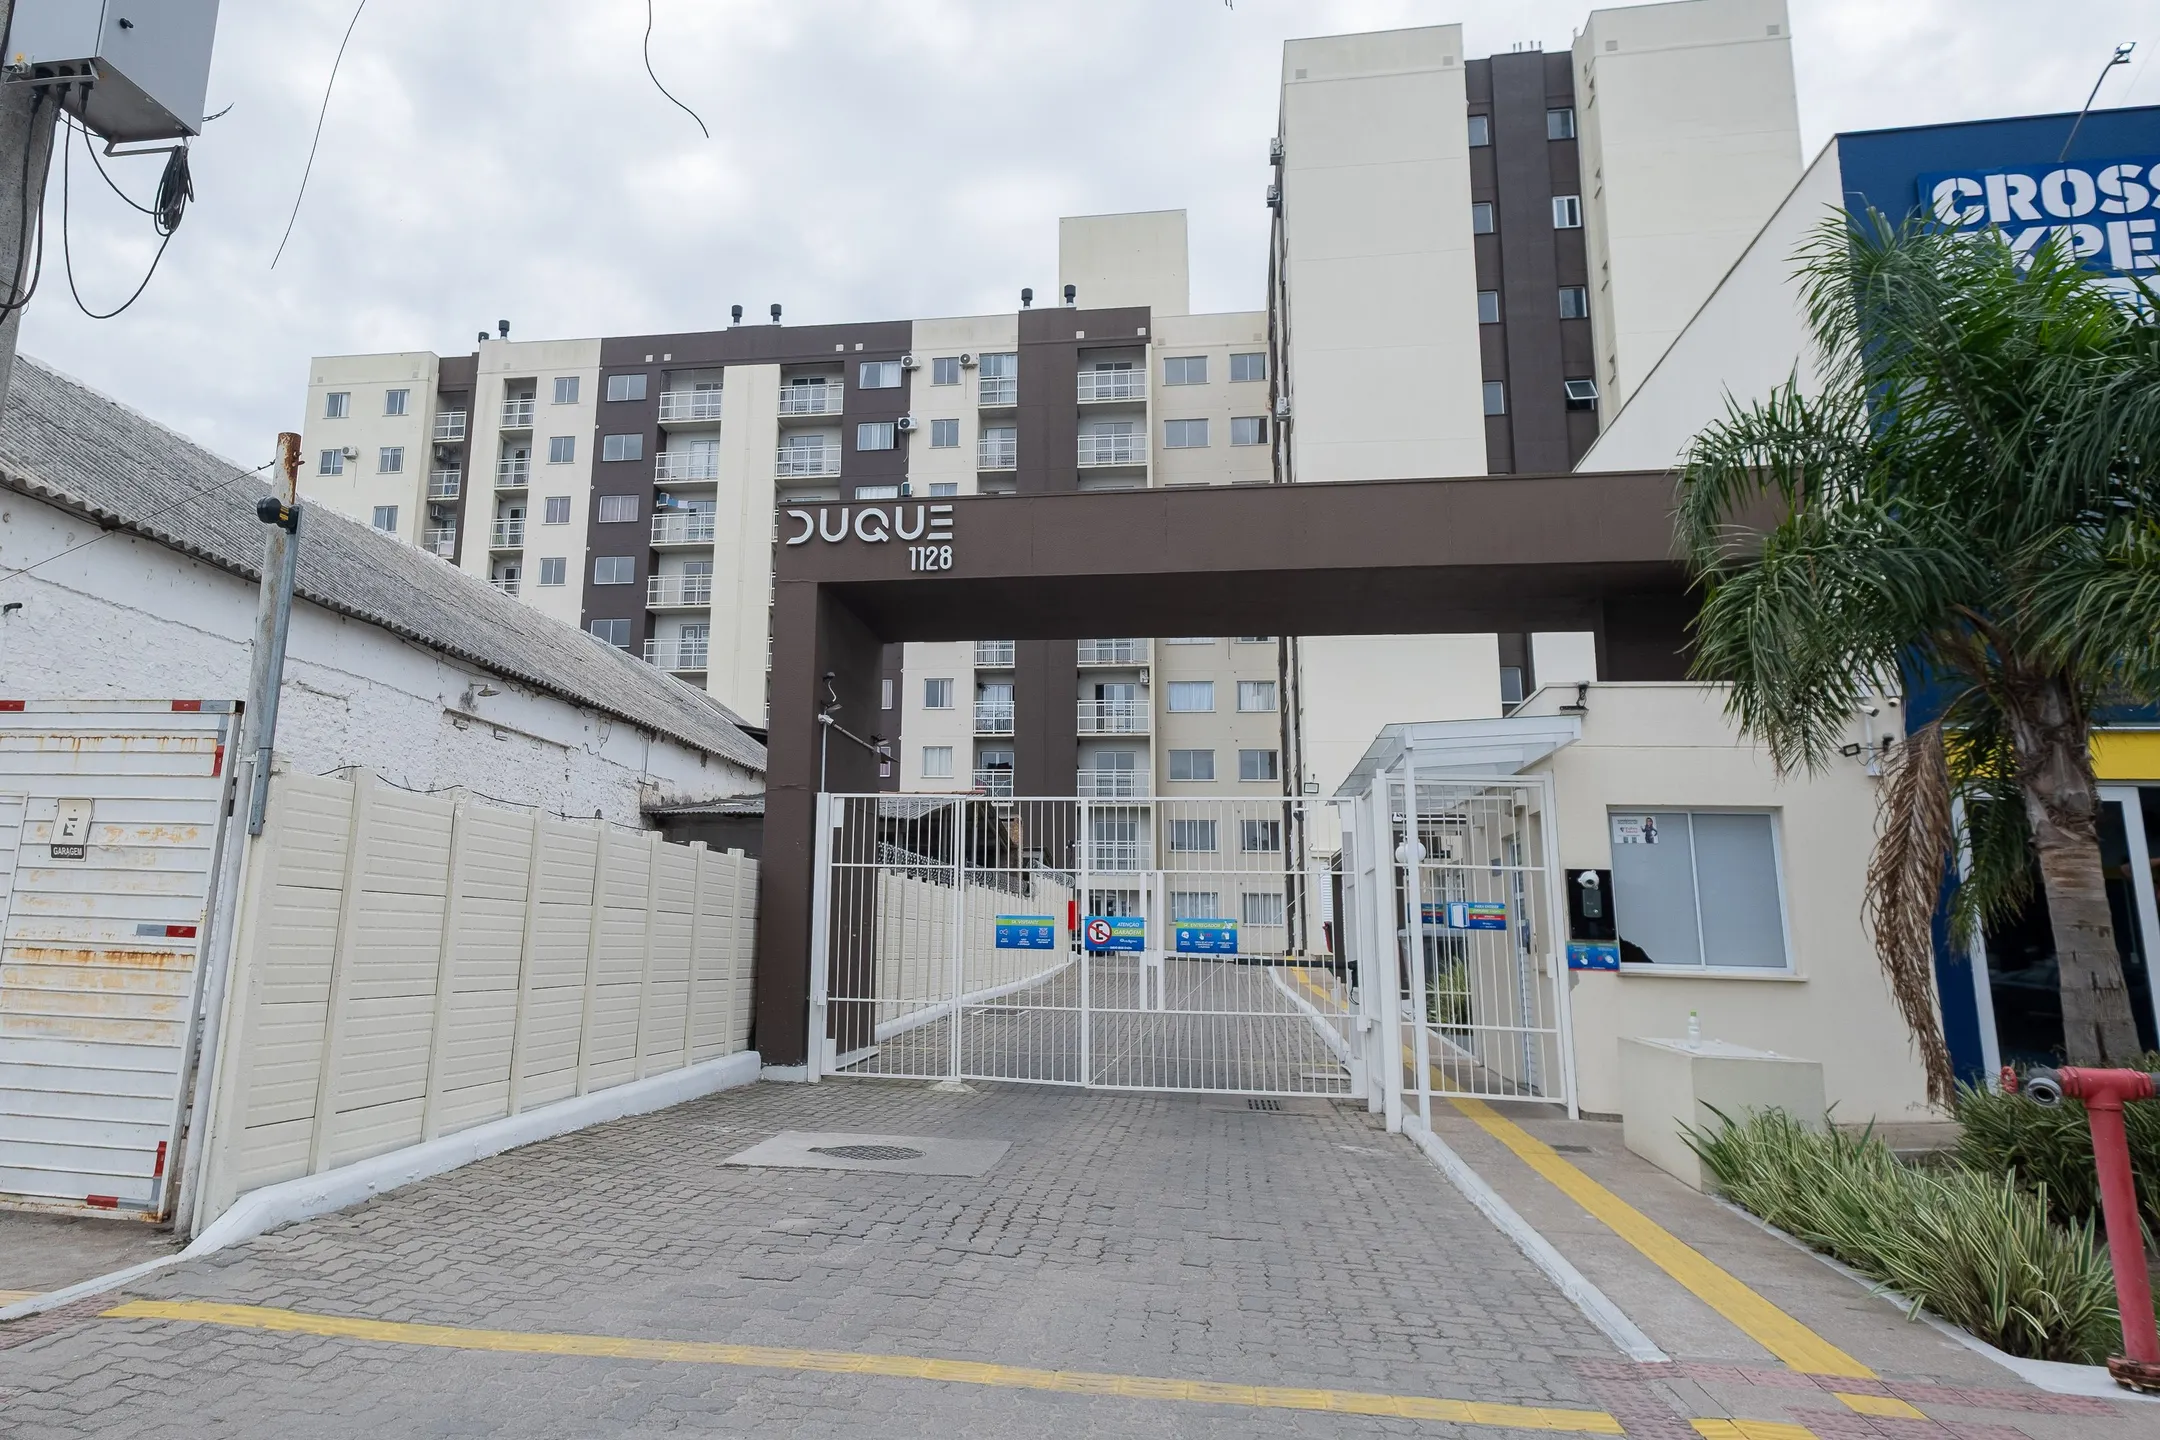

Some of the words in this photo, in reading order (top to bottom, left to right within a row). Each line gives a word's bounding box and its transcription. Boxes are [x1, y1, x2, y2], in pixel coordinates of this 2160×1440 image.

[1932, 163, 2160, 226] CROS
[786, 505, 953, 545] DUQUE
[908, 545, 953, 571] 1128
[53, 846, 83, 856] GARAGEM
